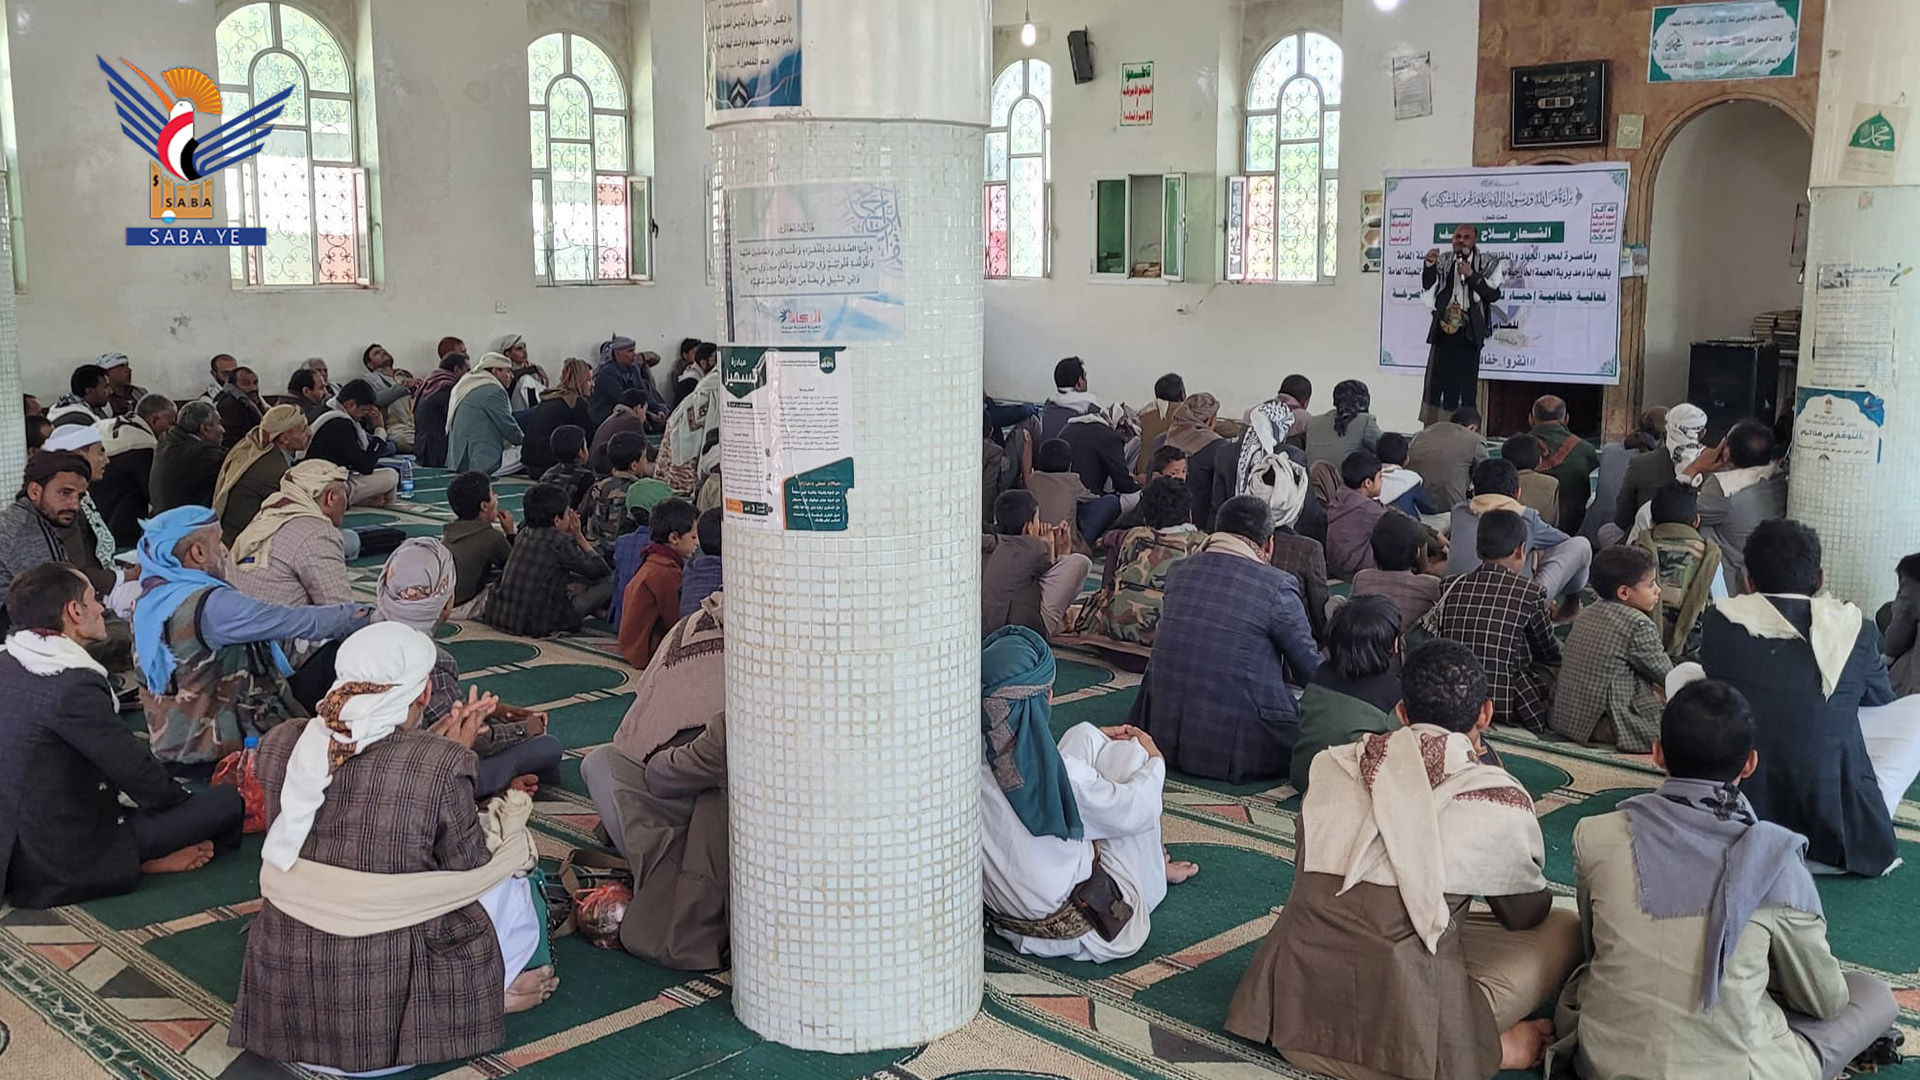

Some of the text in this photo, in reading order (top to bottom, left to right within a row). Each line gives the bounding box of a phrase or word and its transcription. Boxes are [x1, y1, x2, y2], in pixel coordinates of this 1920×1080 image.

[1513, 226, 1551, 241] الشعار
[1392, 288, 1423, 301] لصرخة
[1539, 290, 1573, 304] خطابية
[1577, 290, 1607, 304] فعالية
